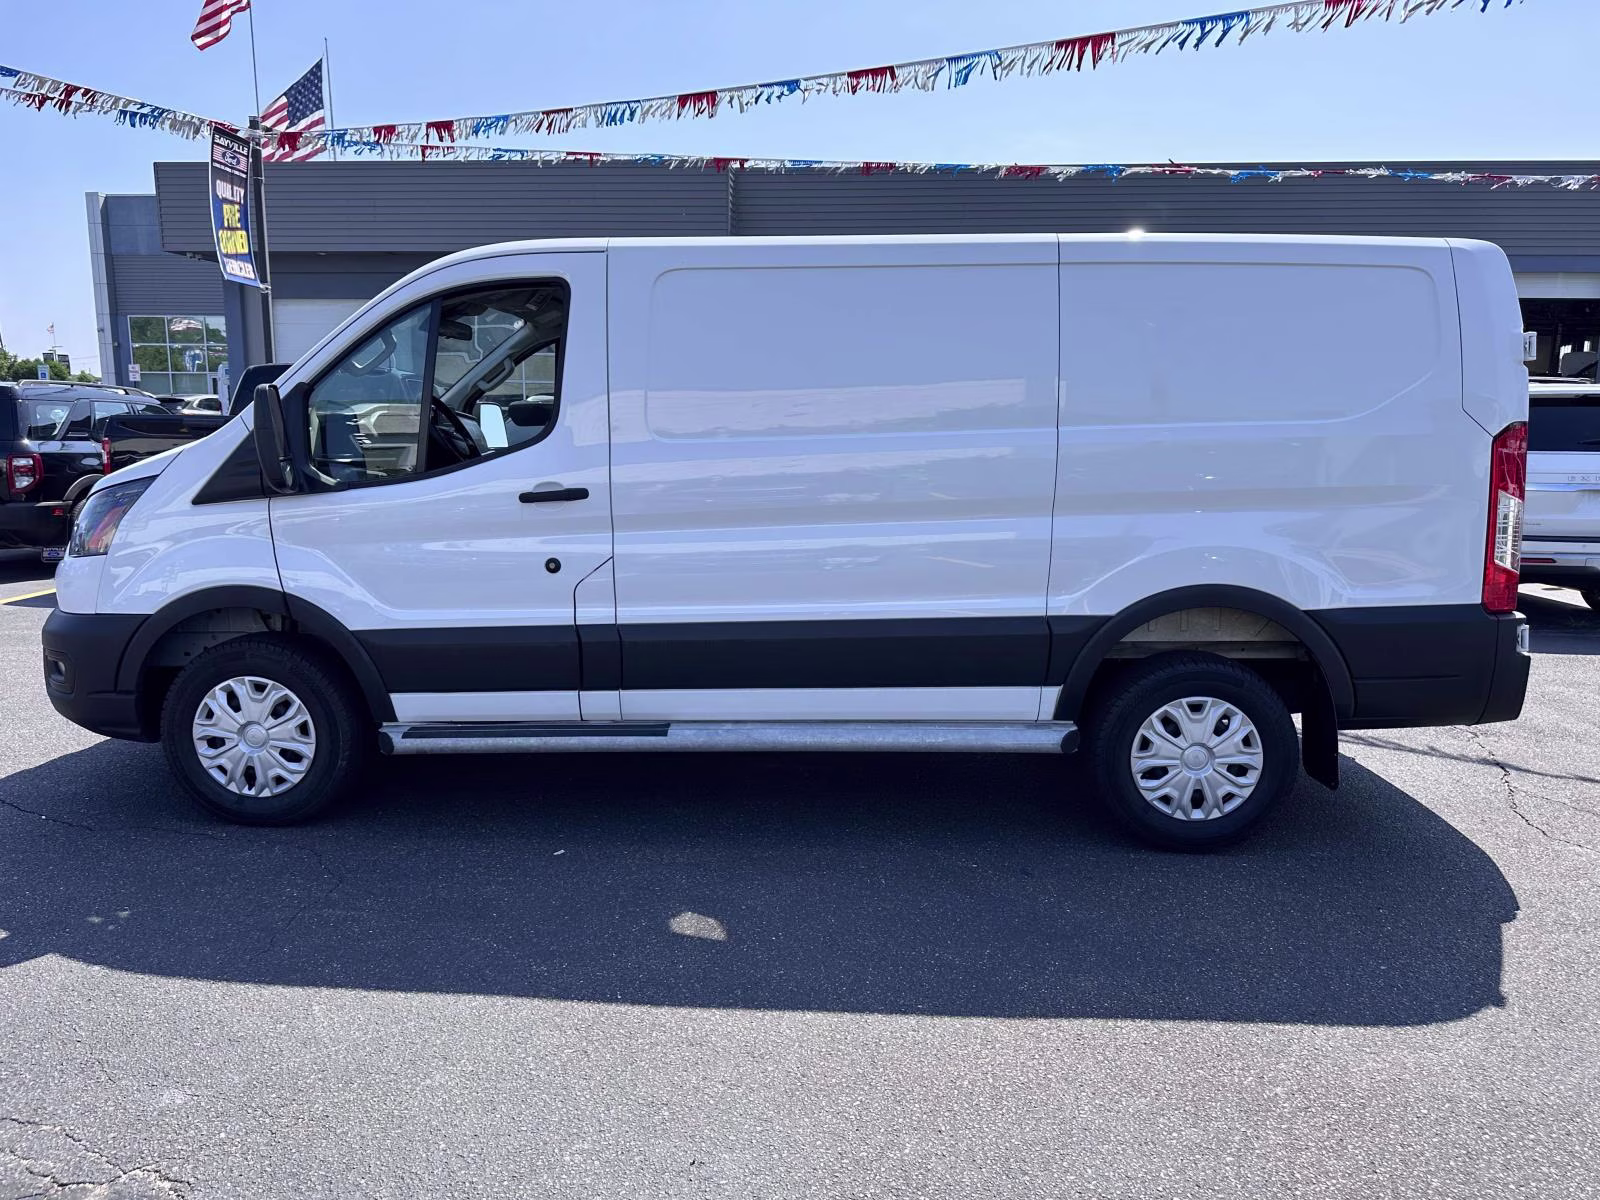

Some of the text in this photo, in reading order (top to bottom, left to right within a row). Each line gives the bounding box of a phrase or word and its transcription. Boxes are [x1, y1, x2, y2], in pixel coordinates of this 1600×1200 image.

[214, 134, 248, 154] SAYVILLE
[216, 180, 245, 204] QUALITY
[223, 204, 241, 228] PRE
